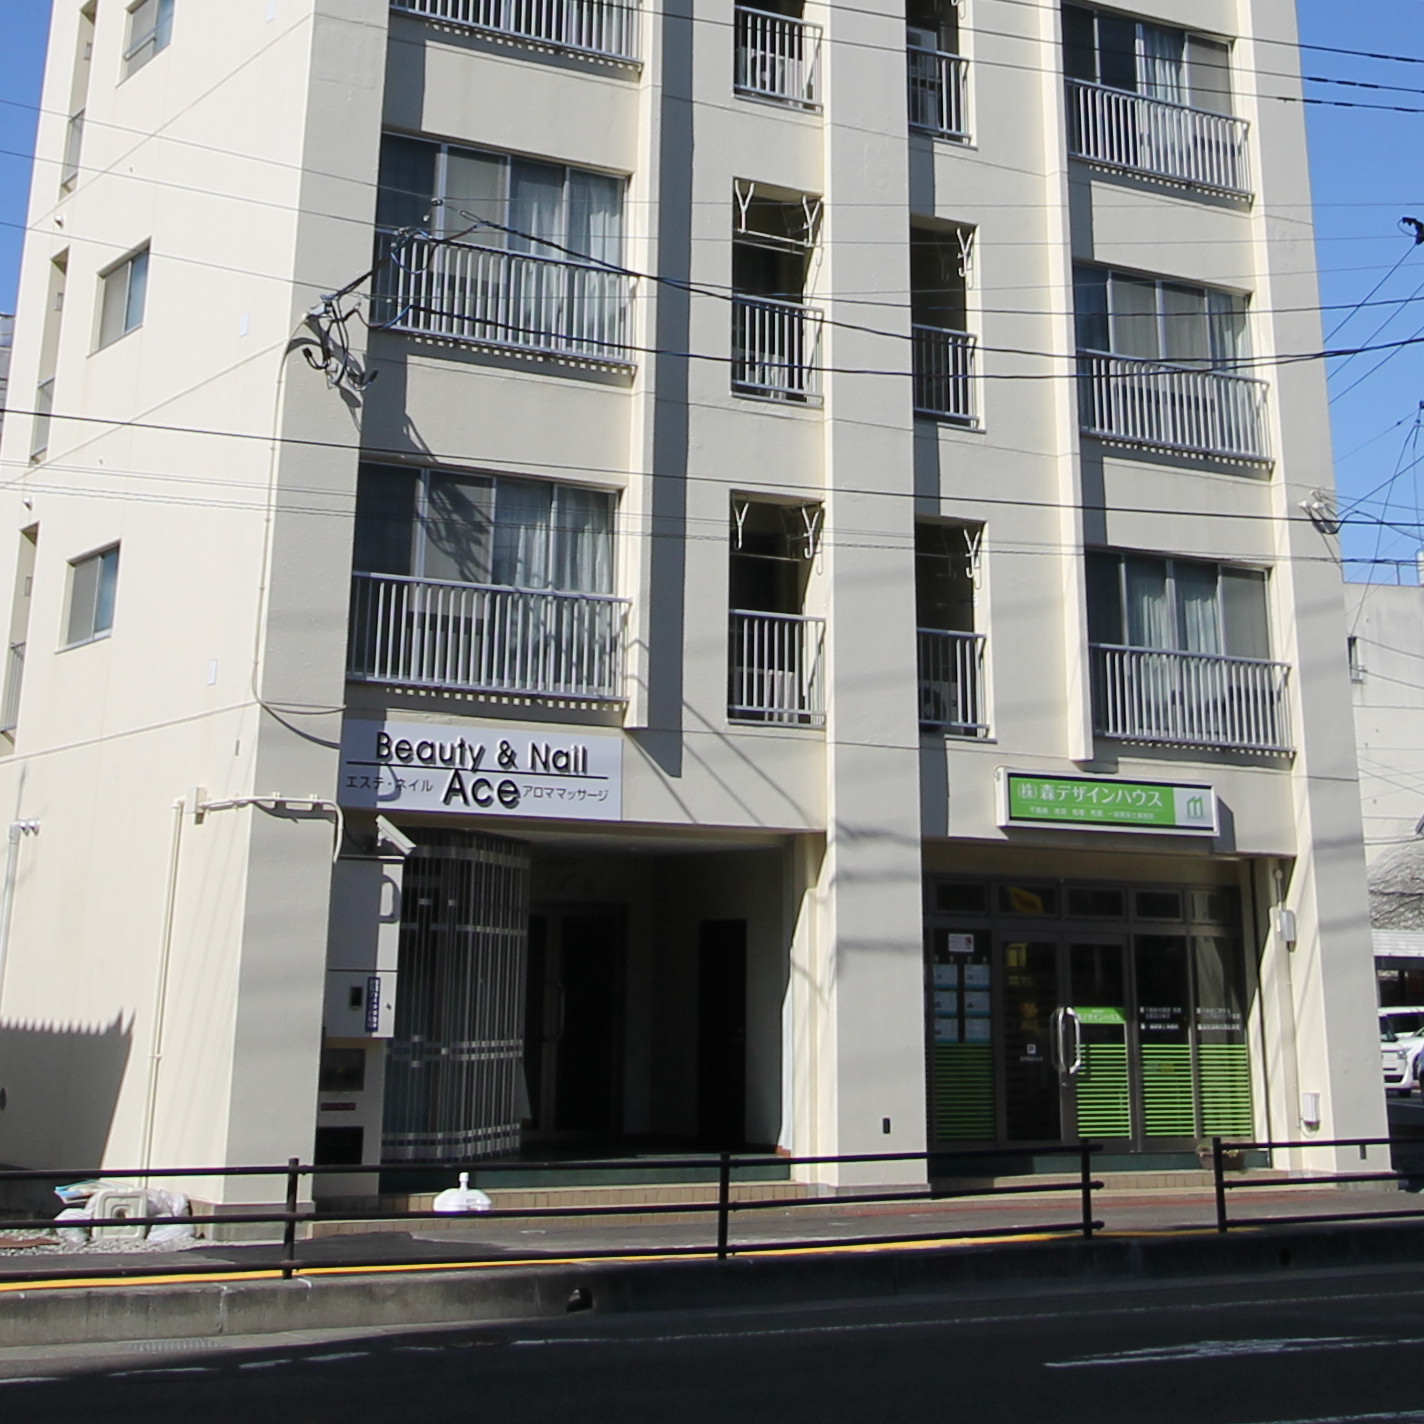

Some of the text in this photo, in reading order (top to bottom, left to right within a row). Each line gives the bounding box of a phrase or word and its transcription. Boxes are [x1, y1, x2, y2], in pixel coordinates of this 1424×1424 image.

[375, 731, 588, 775] Beauty & Nail
[346, 775, 433, 793] エステ・ネイル
[442, 768, 521, 808] Ace
[522, 784, 609, 802] アロママッサージ
